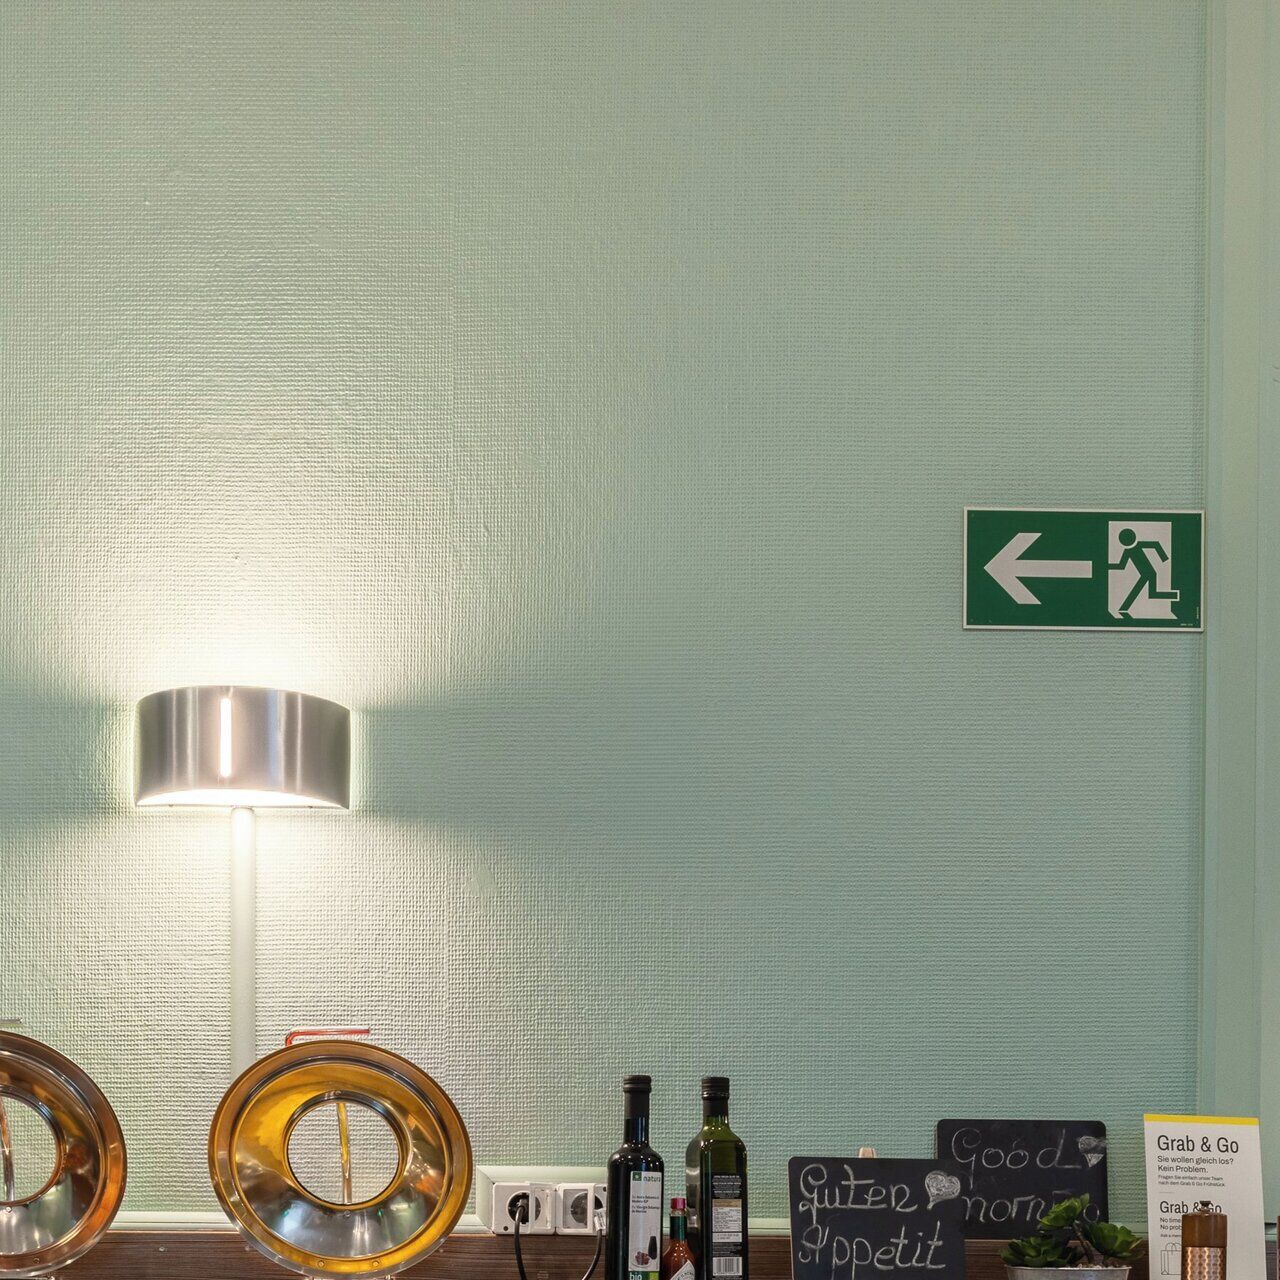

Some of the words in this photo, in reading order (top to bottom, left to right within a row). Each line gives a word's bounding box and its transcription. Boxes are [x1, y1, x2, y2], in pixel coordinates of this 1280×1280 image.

[1157, 1134, 1195, 1152] Grab
[1200, 1136, 1212, 1153] &
[1216, 1137, 1239, 1154] Go
[950, 1126, 1083, 1190] Good
[1170, 1156, 1194, 1164] wollen
[1196, 1157, 1218, 1166] gleich
[1176, 1165, 1209, 1174] Problem.
[798, 1163, 919, 1226] Guten
[1160, 1200, 1188, 1214] Grab
[1192, 1202, 1202, 1213] &
[628, 1272, 642, 1280] bio
